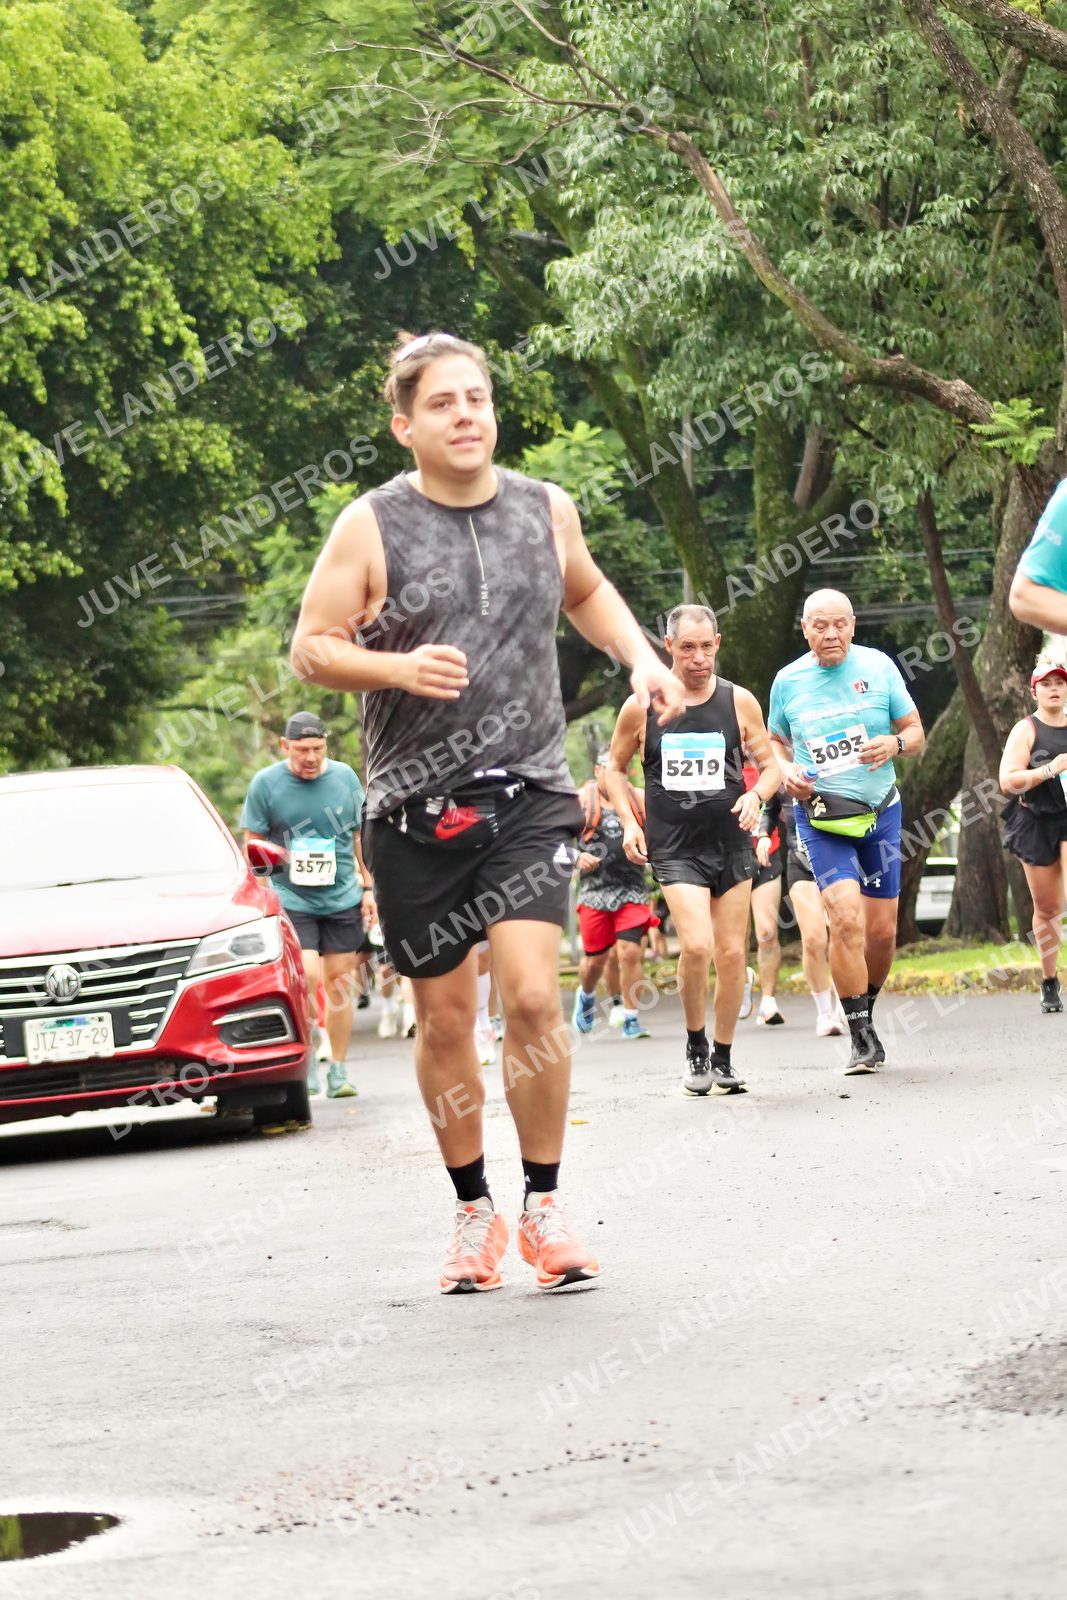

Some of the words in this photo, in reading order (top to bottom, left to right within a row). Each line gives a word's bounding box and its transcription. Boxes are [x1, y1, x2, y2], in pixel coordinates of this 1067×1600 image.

[480, 582, 490, 616] PUMA
[812, 734, 865, 765] 3093
[666, 758, 720, 777] 5219
[295, 859, 333, 873] 3577
[32, 1027, 109, 1052] JTZ-37-29
